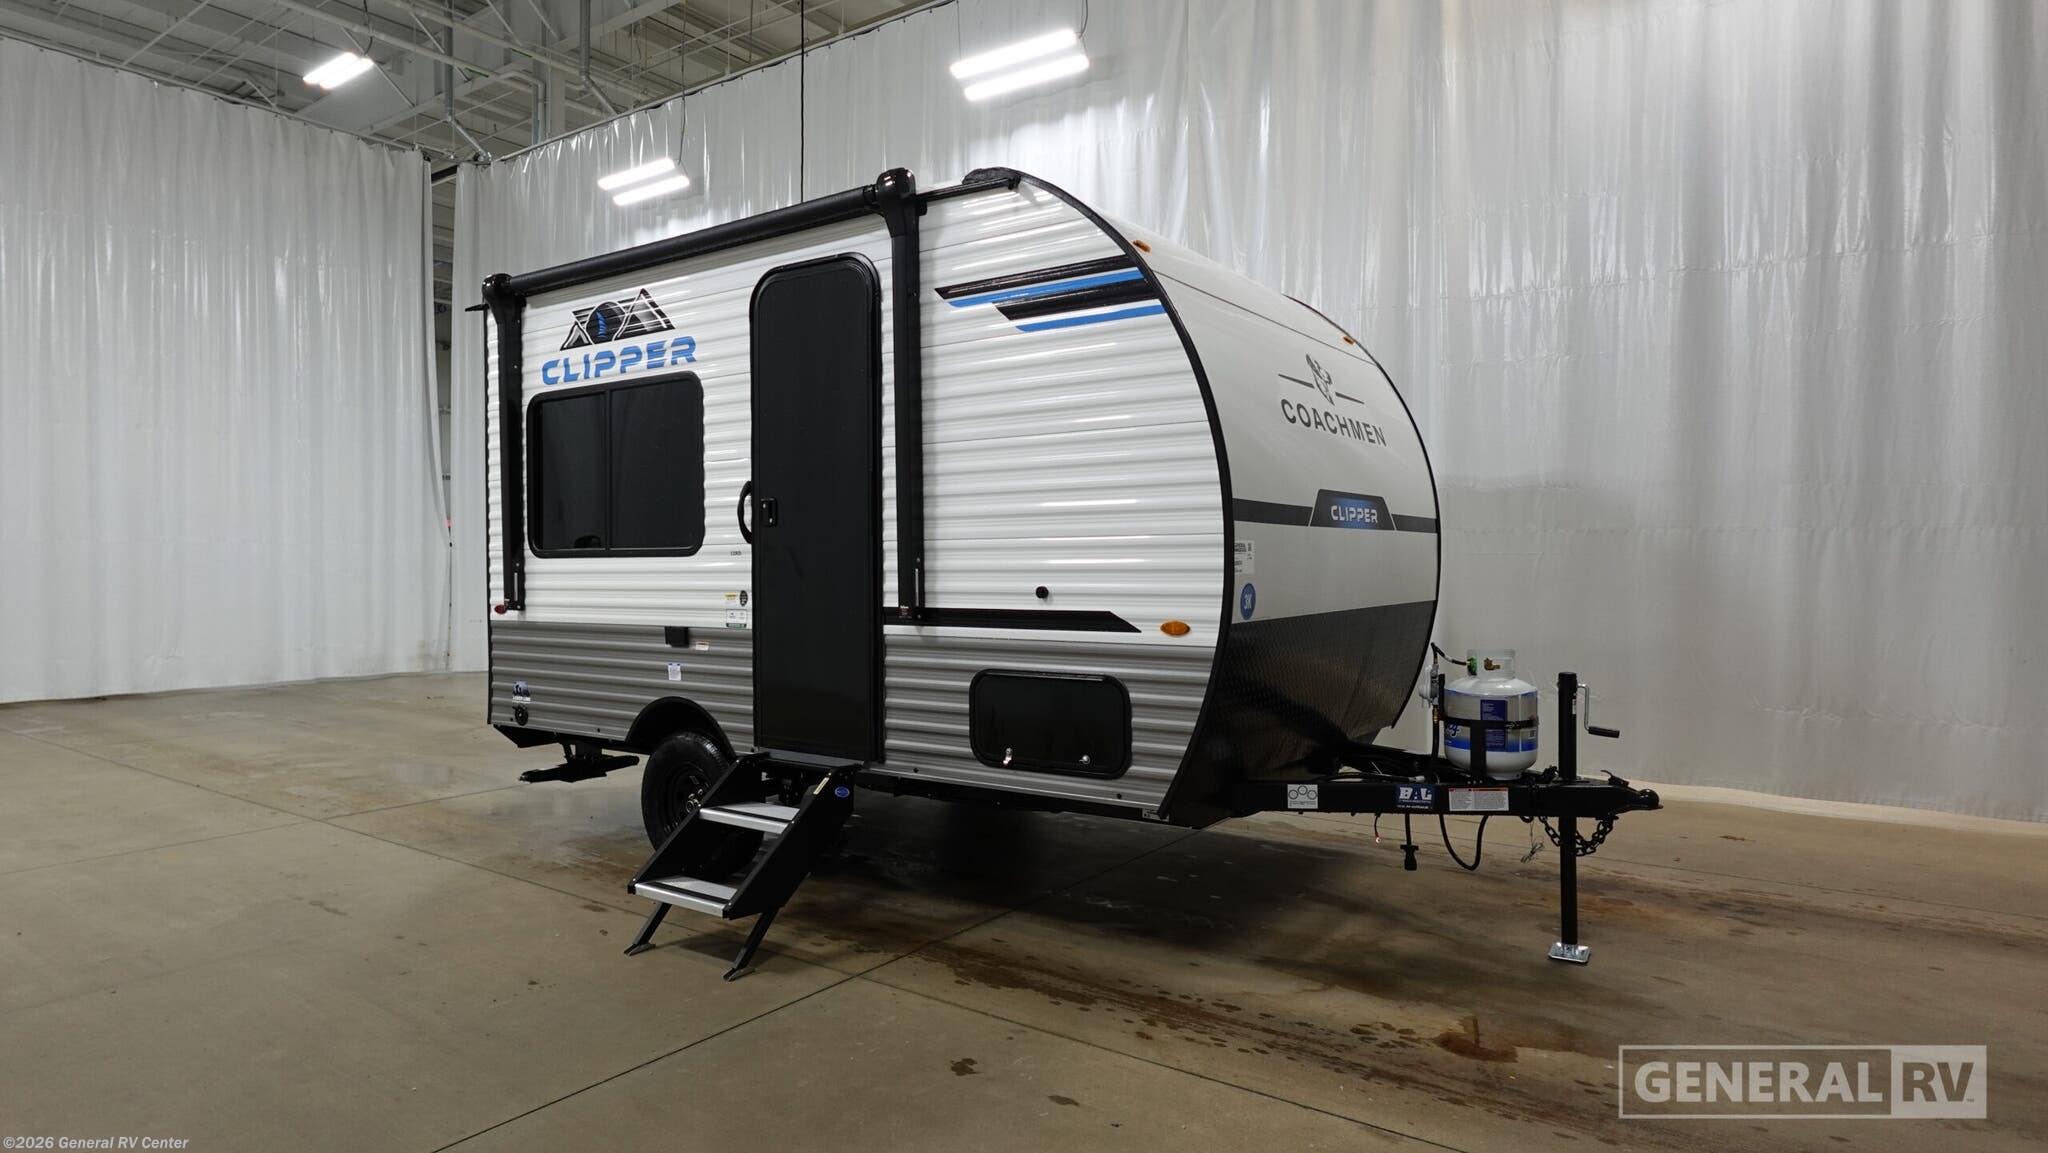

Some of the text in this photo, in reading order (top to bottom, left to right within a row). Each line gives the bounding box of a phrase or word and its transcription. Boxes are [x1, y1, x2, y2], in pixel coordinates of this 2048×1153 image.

[541, 335, 697, 385] CLIPPER
[1280, 398, 1387, 447] COACHMEN
[1330, 505, 1379, 524] CLIPPER
